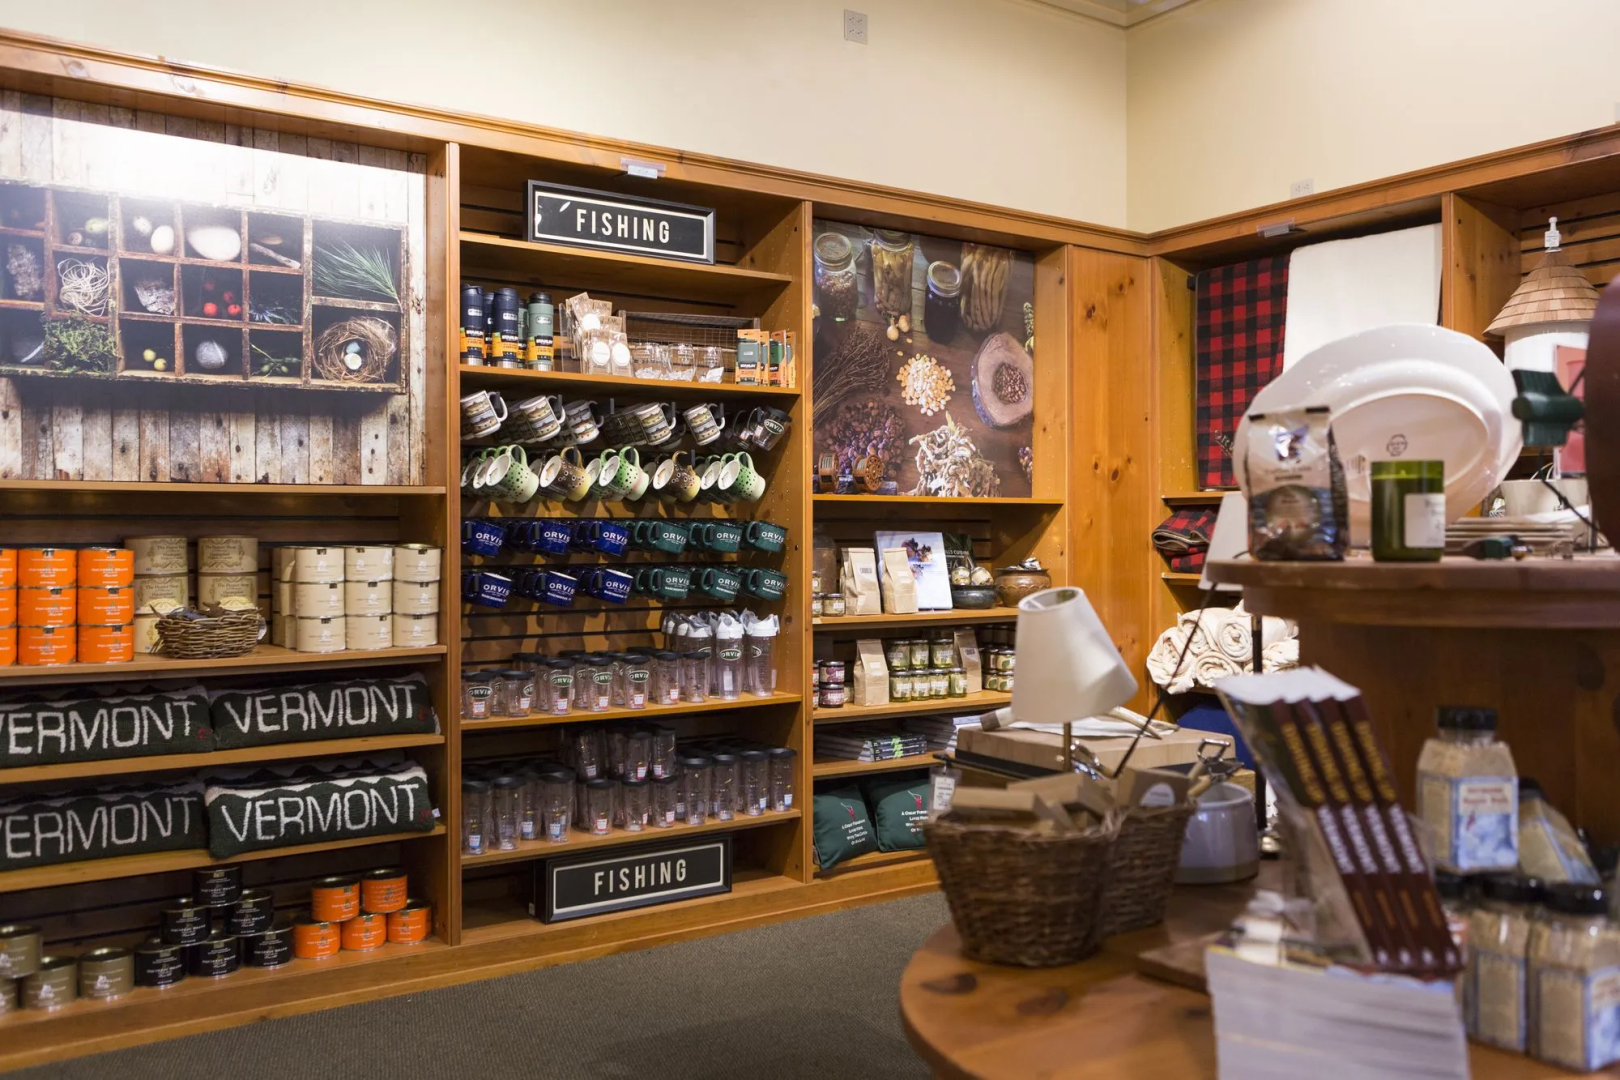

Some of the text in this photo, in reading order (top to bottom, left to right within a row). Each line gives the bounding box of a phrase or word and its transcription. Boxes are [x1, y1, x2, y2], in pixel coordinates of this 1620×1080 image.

[576, 208, 670, 244] FISHING
[476, 532, 503, 546] ORVIS
[543, 531, 571, 544] ORVIS
[603, 531, 628, 545] ORVIS
[663, 532, 687, 545] ORVIS
[716, 532, 741, 543] ORVIS
[761, 531, 784, 543] ORVIS
[605, 580, 630, 593] ORVIS
[665, 576, 690, 587] ORVIS
[718, 577, 741, 589] ORVIS
[764, 578, 785, 589] ORVIS
[483, 583, 510, 597] ORVIS
[549, 582, 576, 596] ORVIS
[224, 685, 418, 734] VERMONT
[222, 783, 419, 842] VERMONT
[593, 858, 687, 896] FISHING
